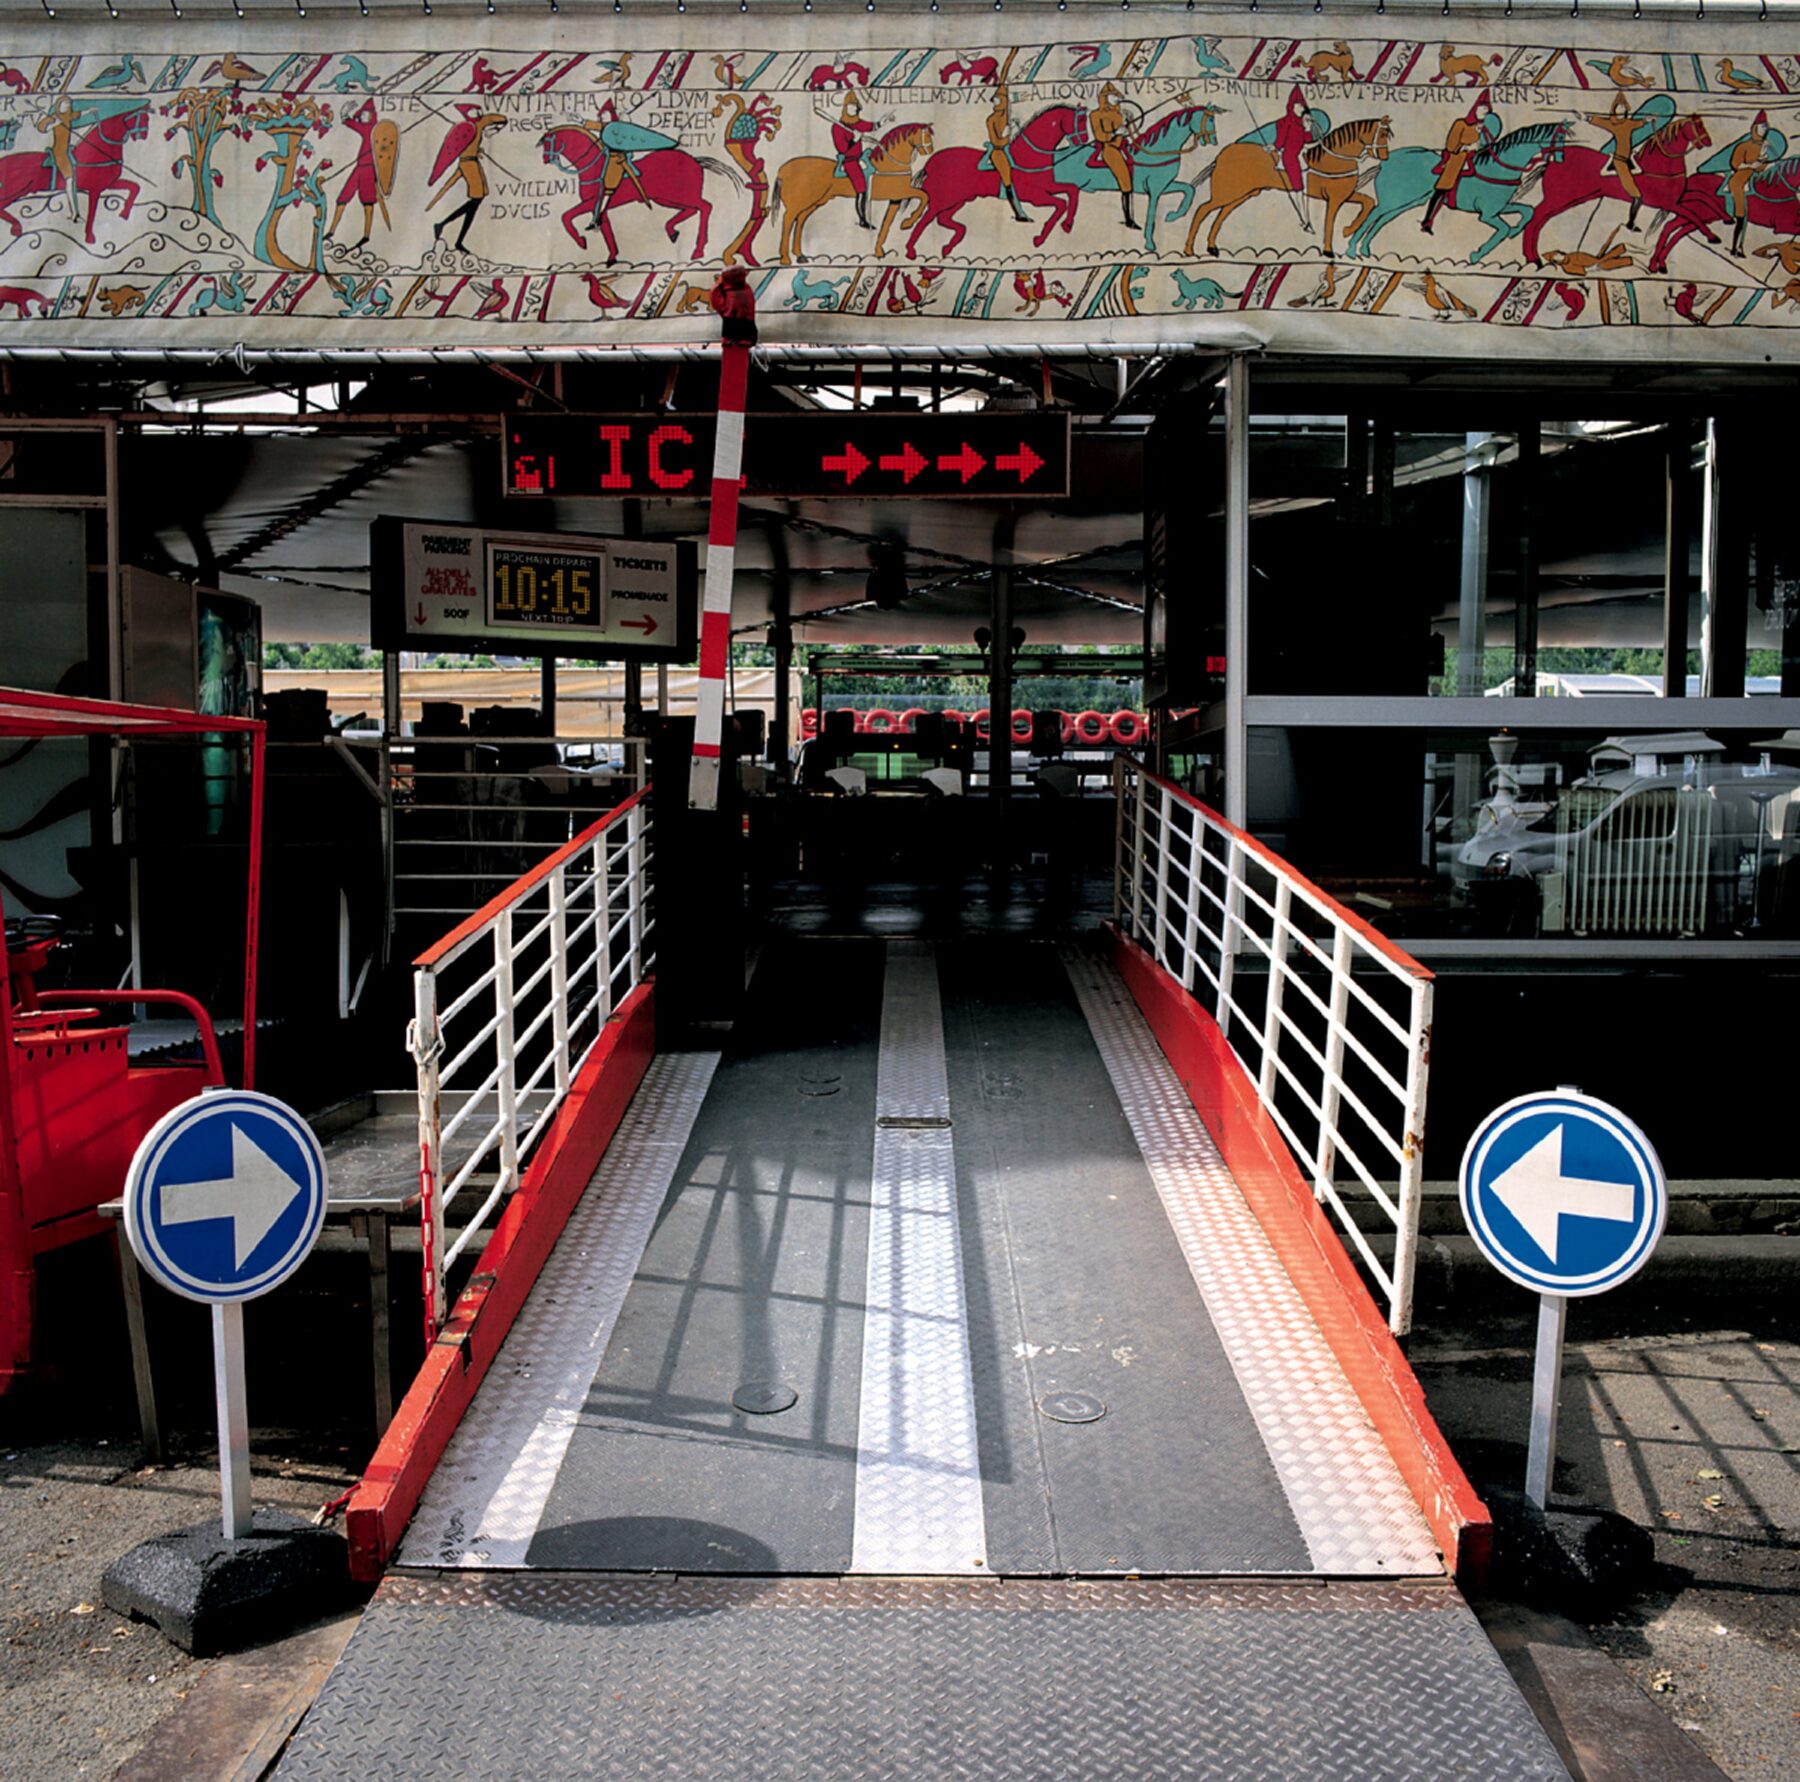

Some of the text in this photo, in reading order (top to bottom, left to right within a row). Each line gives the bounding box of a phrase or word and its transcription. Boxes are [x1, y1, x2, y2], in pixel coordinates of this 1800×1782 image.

[381, 97, 420, 113] ISTE
[813, 93, 842, 108] HIC
[491, 203, 550, 220] DVCIS
[496, 552, 550, 566] PROCHAIN
[613, 557, 668, 572] TICKETS
[496, 565, 591, 615] 10:15
[611, 590, 668, 602] PROMENADE
[521, 613, 548, 623] NEXT
